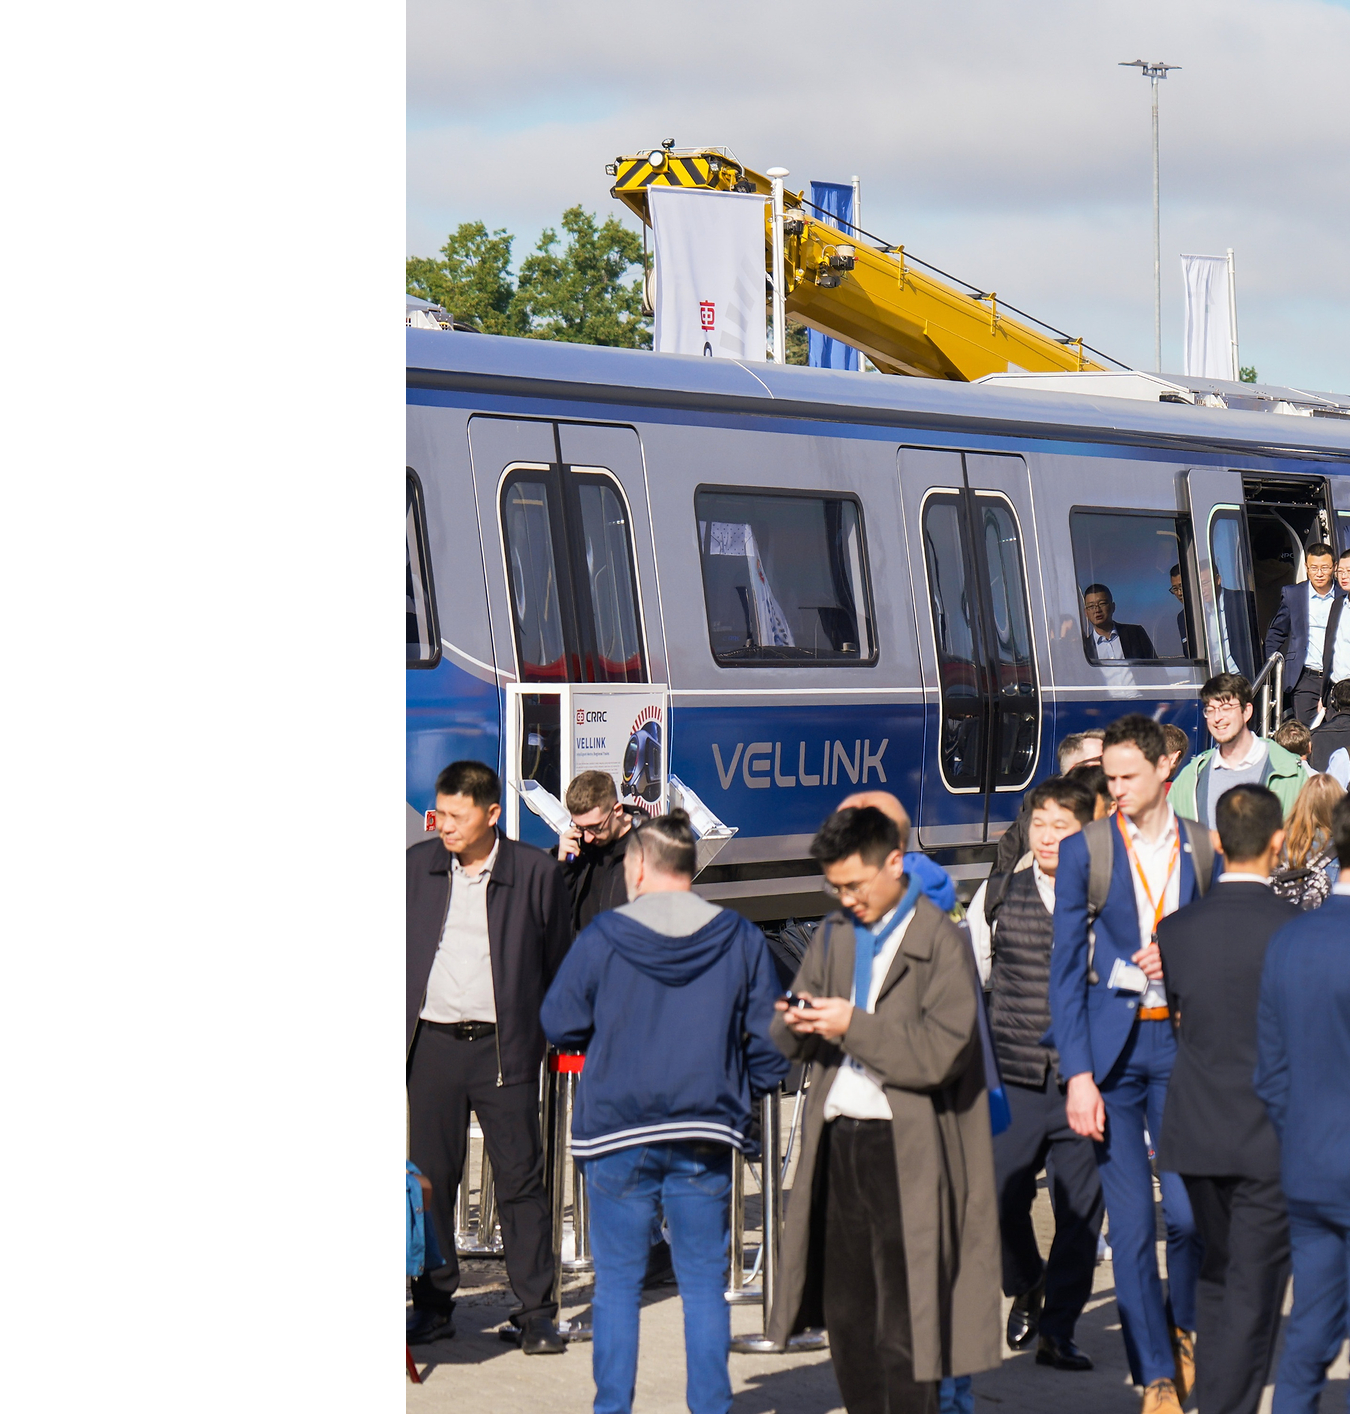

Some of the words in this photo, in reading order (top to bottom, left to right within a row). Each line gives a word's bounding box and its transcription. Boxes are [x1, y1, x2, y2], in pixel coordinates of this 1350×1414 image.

[586, 711, 608, 722] CRRC
[576, 737, 607, 749] VELLINK
[711, 738, 889, 790] VELLINK
